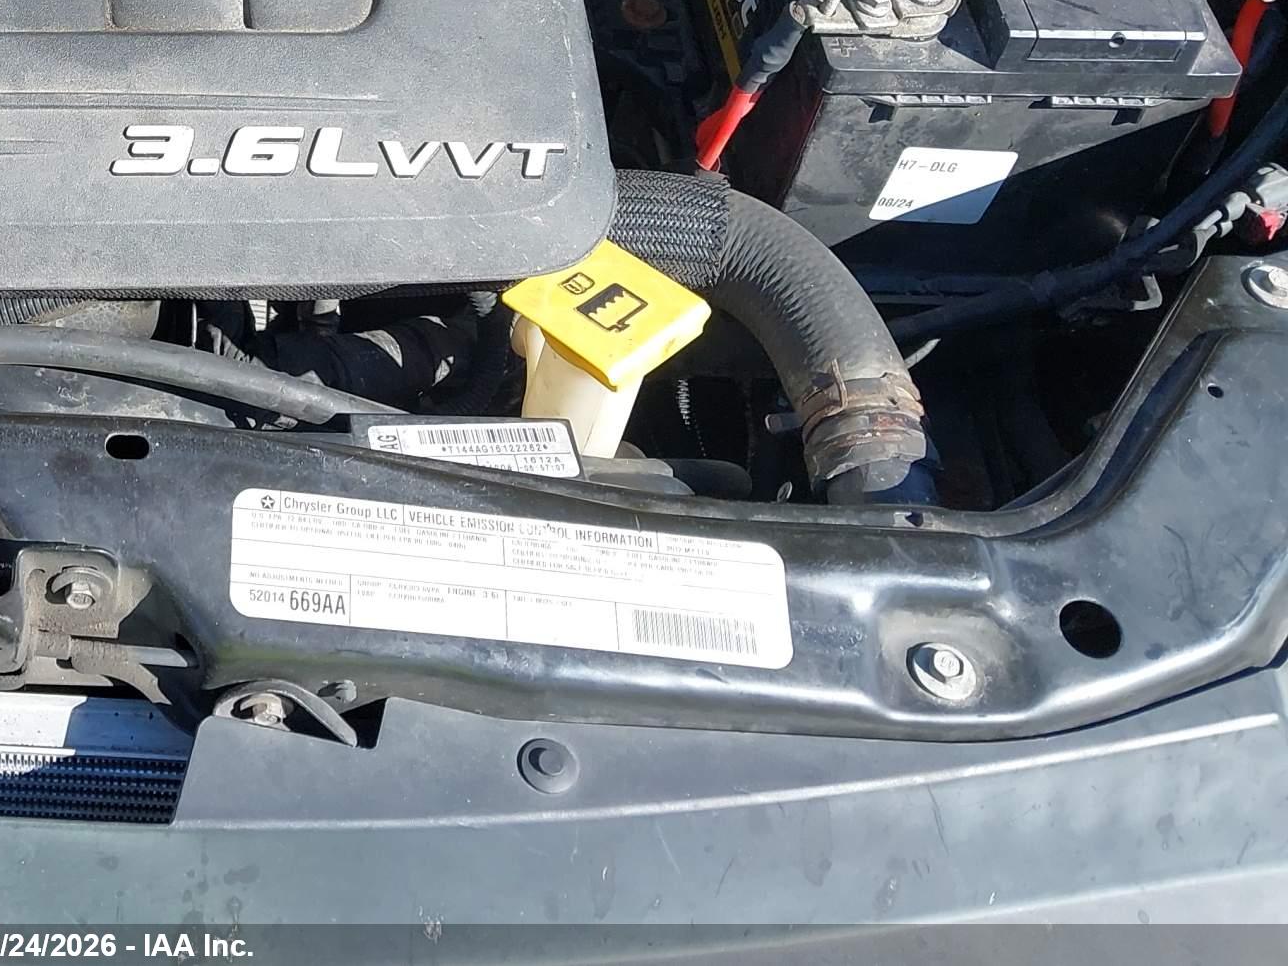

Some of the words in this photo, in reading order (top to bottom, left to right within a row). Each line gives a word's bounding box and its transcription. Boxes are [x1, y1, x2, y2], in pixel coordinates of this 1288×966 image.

[109, 125, 379, 178] 3.6L
[379, 140, 567, 180] VVT
[877, 197, 914, 209] 08/24
[284, 497, 332, 513] Chrysler
[336, 502, 372, 519] Group
[376, 507, 398, 521] LLC
[409, 510, 455, 527] VEHICLE
[460, 516, 514, 533] EMISSION
[575, 529, 653, 548] INFORMATION
[249, 589, 285, 603] 52014
[290, 590, 346, 615] 669AA
